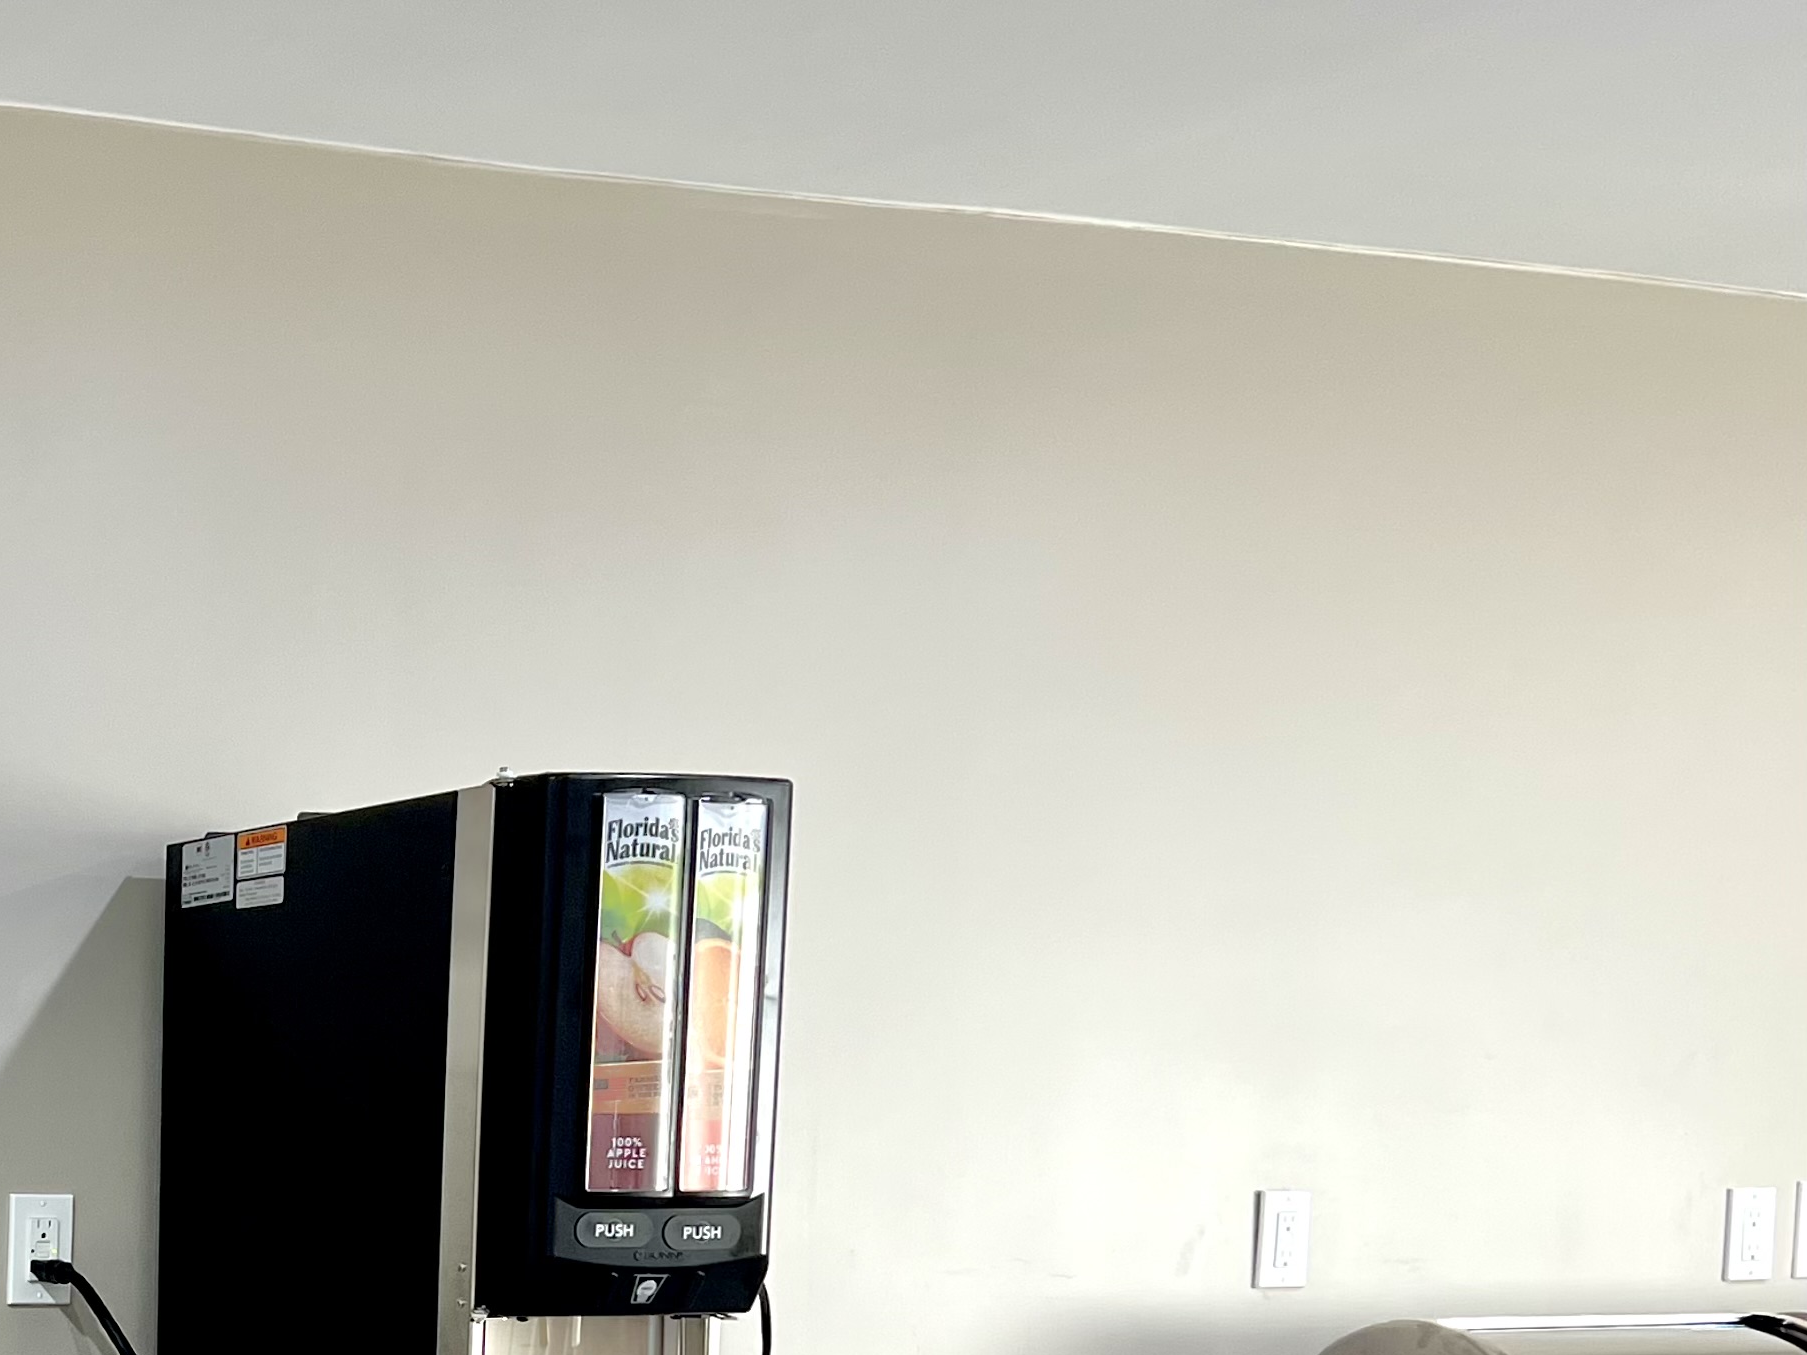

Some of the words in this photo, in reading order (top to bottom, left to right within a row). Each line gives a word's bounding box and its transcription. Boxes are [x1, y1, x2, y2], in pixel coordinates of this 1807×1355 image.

[605, 838, 676, 863] Natural
[699, 848, 758, 872] Natural
[612, 1137, 642, 1148] 100%
[607, 1148, 647, 1158] APPLE
[608, 1158, 645, 1169] JUICE
[595, 1223, 635, 1238] PUSH
[683, 1225, 723, 1240] PUSH
